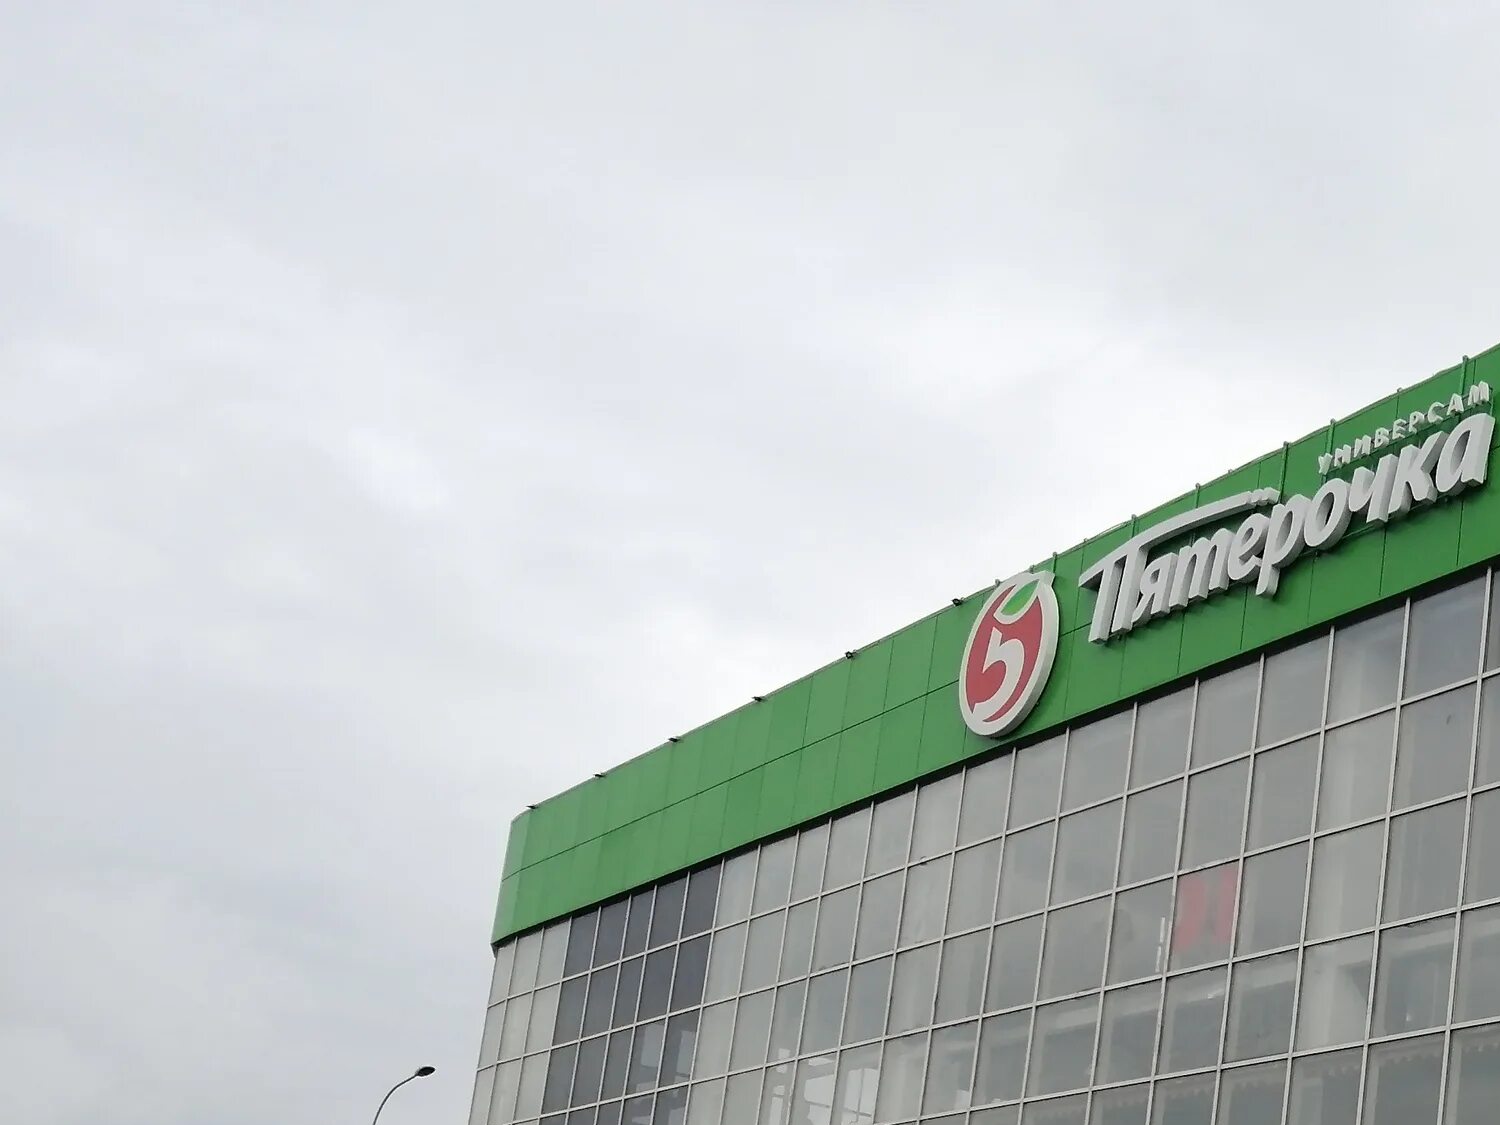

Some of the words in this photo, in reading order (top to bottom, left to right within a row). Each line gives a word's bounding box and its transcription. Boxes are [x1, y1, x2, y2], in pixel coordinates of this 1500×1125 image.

[1317, 380, 1491, 476] УНИВЕРСАМ
[1079, 411, 1495, 645] Пятерочка
[972, 625, 1026, 722] 5
